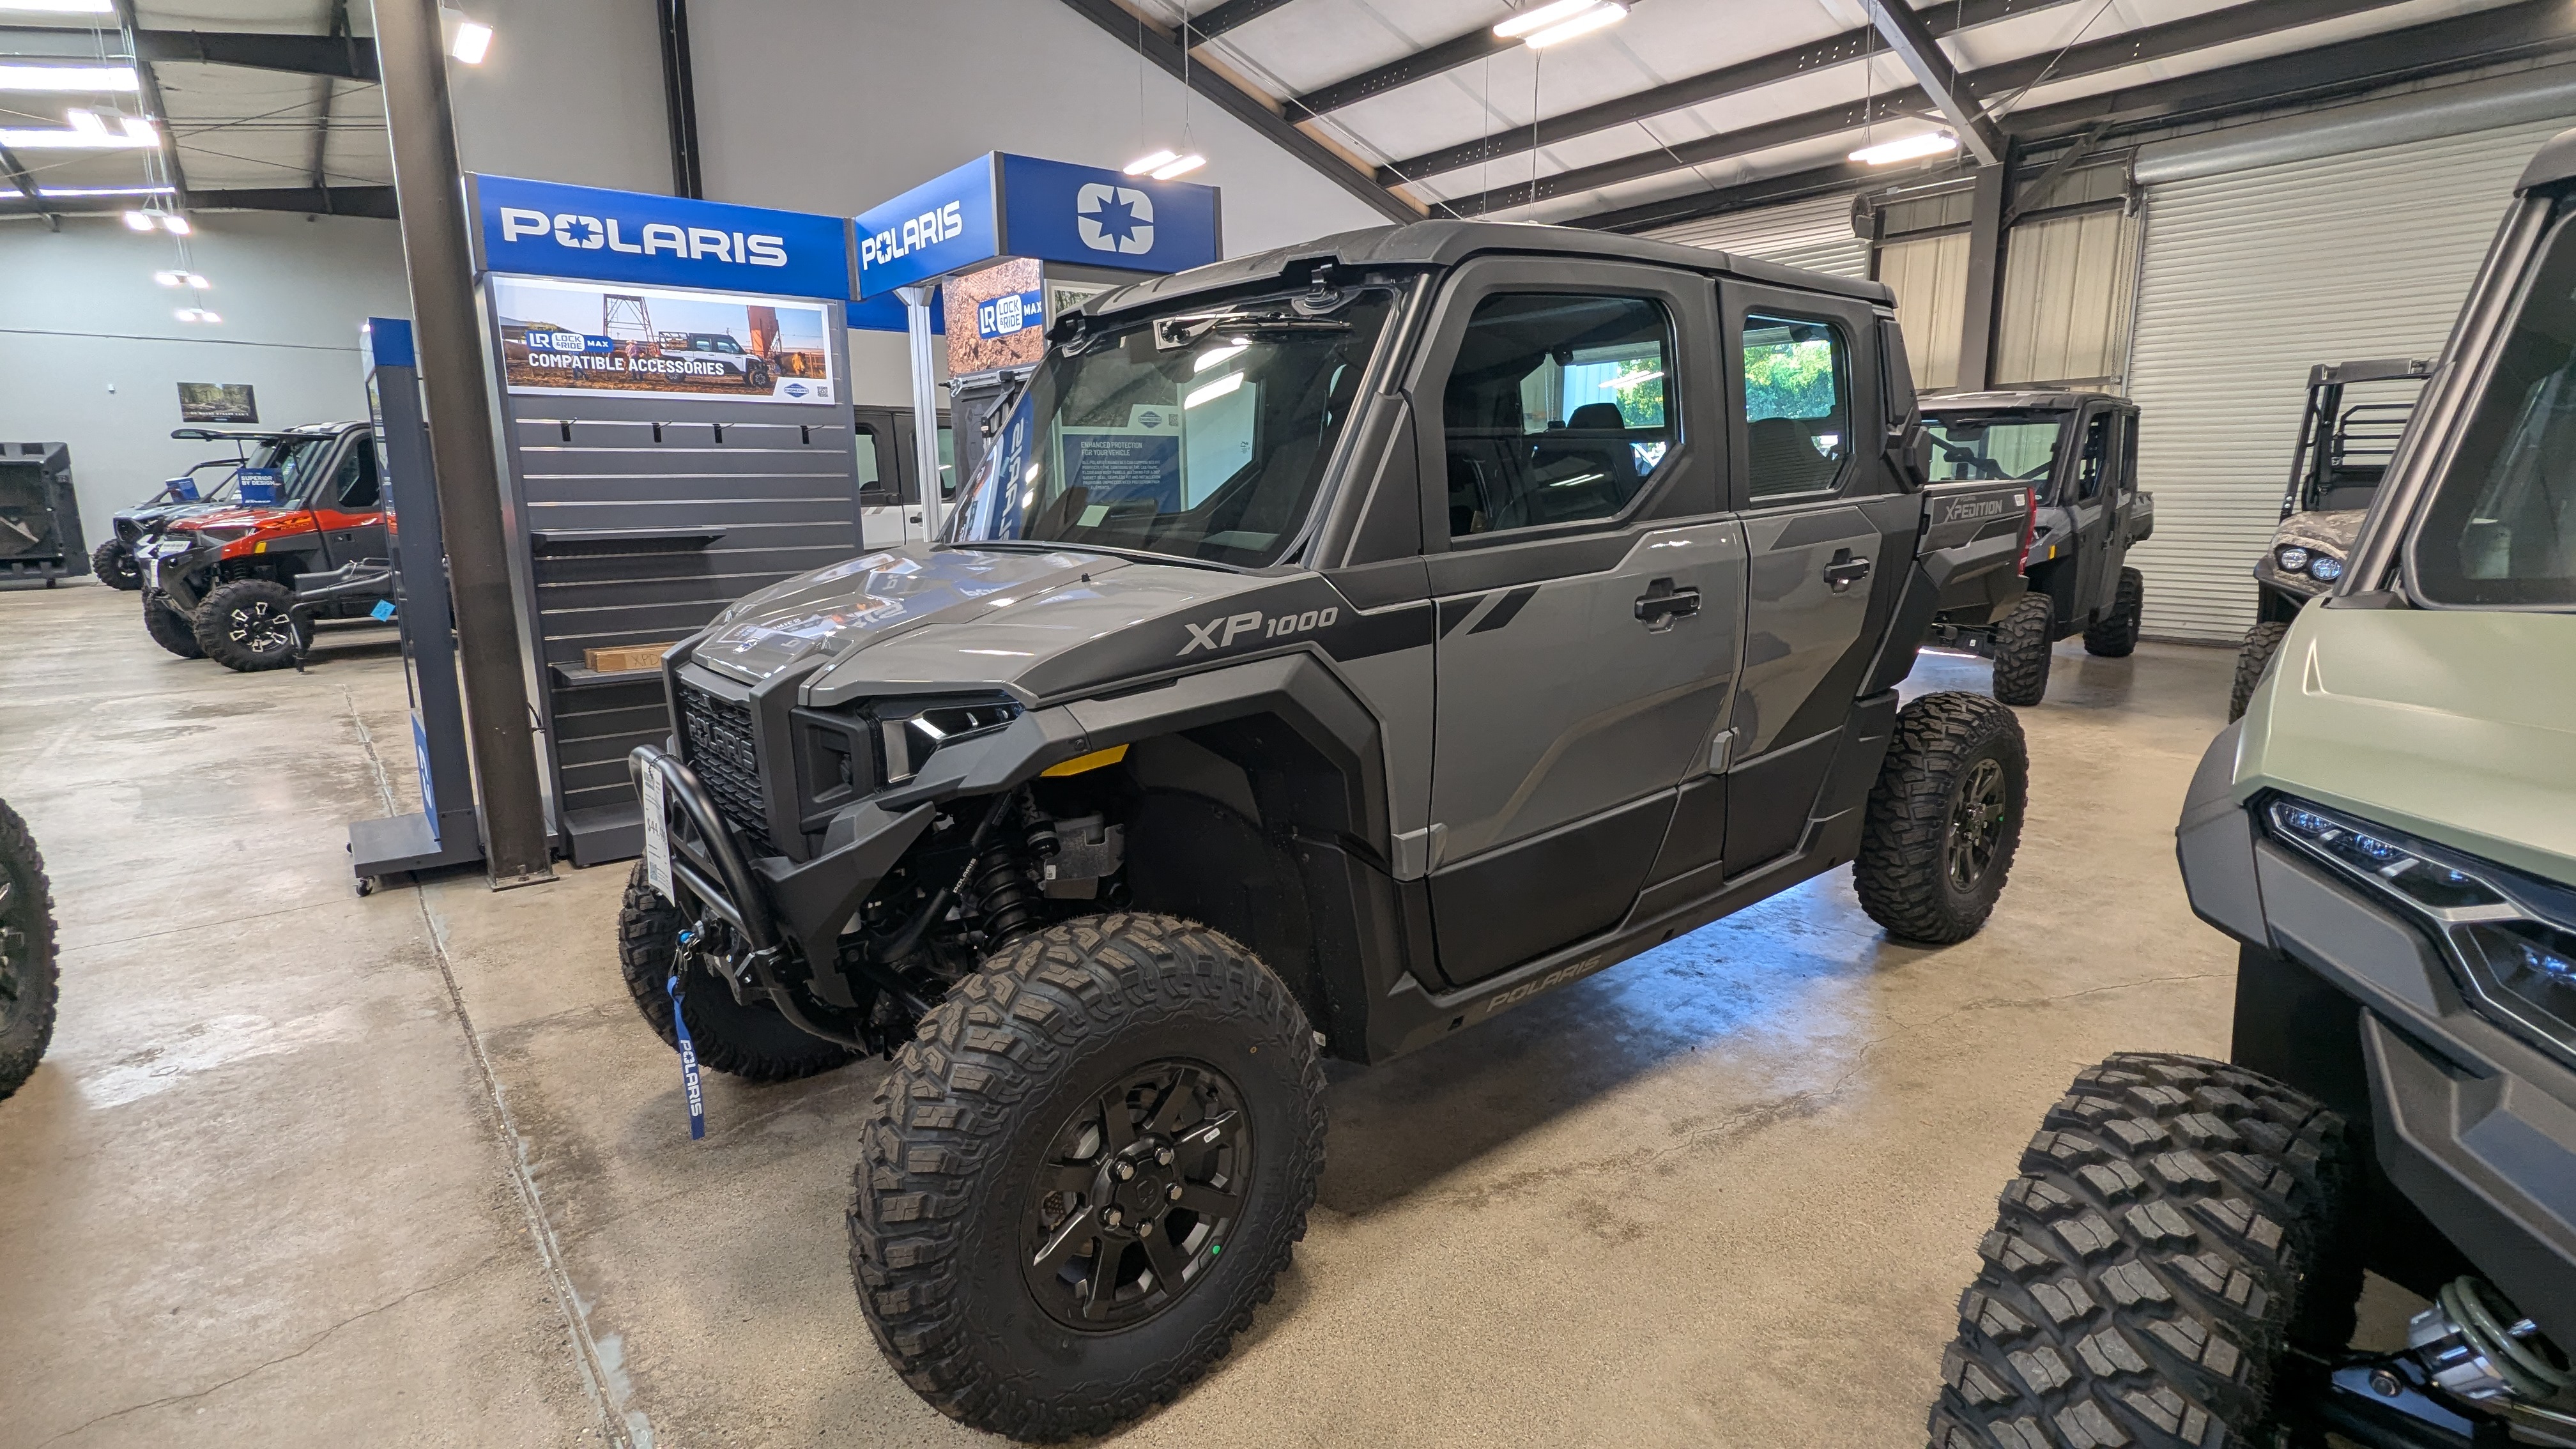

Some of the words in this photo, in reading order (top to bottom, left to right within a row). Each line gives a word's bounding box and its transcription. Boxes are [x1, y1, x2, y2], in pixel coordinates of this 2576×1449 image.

[500, 206, 788, 267] POLARIS
[861, 199, 963, 270] POLARIS
[980, 305, 997, 335] LR
[999, 298, 1020, 318] LOCK
[1000, 313, 1021, 330] &RIDE
[1023, 300, 1042, 317] MAX
[529, 333, 551, 349] LR
[555, 334, 581, 344] LOCK
[555, 341, 583, 351] &RIDE
[586, 339, 609, 348] MAX
[528, 353, 625, 372] COMPATIBLE
[628, 356, 724, 376] ACCESSORIES
[1943, 497, 2003, 524] XPEDITION
[1176, 610, 1262, 657] XP
[1266, 606, 1339, 639] 1000
[686, 710, 755, 771] POLARIS
[953, 857, 977, 894] POLARIS
[1485, 954, 1603, 1013] POLARIS
[680, 1039, 703, 1117] POLARIS
